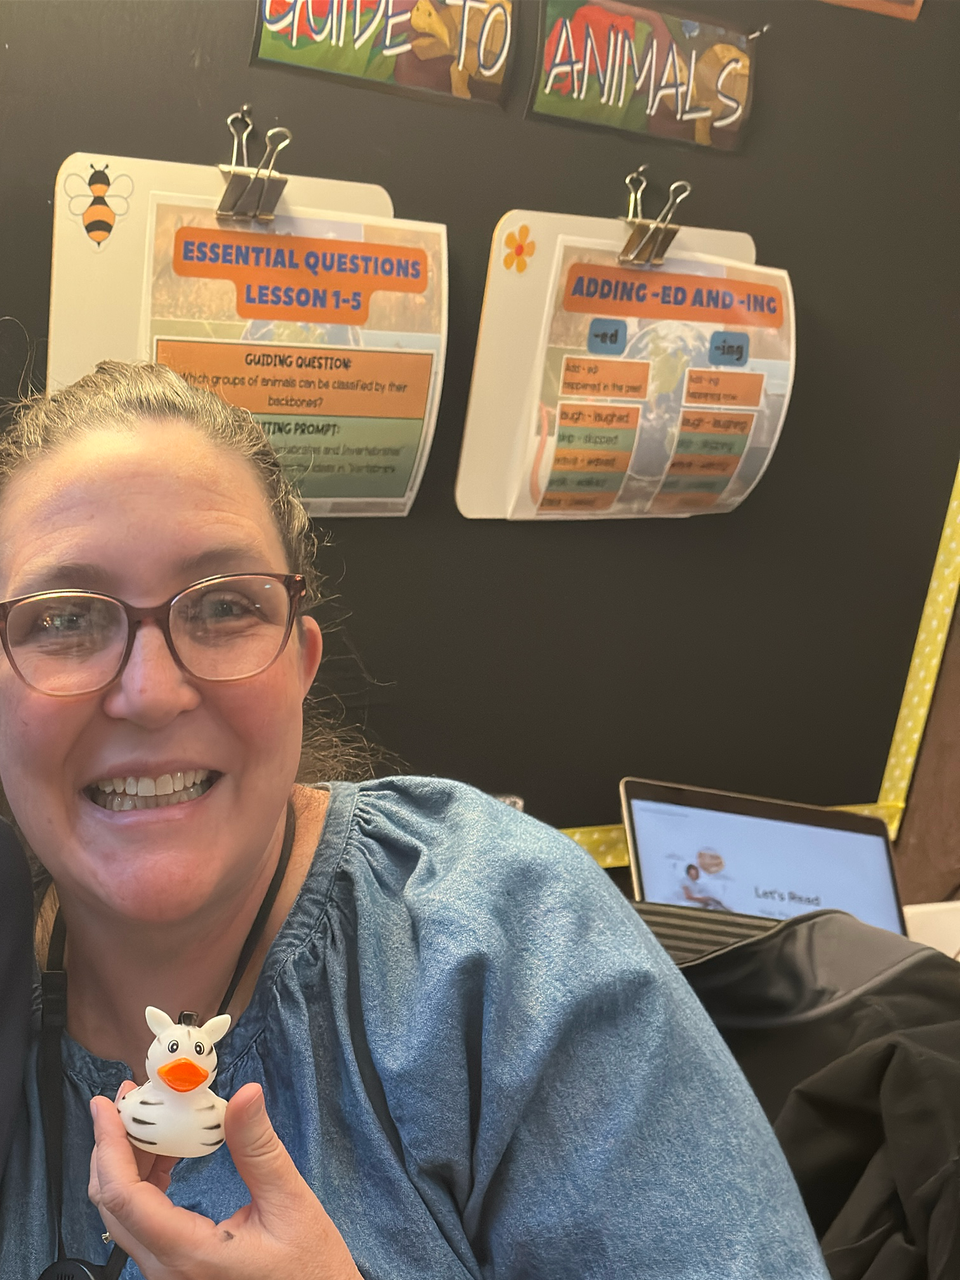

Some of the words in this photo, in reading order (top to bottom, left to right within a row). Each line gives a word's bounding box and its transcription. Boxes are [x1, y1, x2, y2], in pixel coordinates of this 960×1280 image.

[447, 0, 511, 76] TO
[543, 17, 743, 127] ANIMALS
[183, 240, 299, 269] ESSENTIAL
[304, 250, 421, 280] QUESTIONS
[245, 284, 328, 309] LESSON
[332, 290, 362, 311] 1-5
[571, 275, 647, 303] ADDING
[651, 286, 687, 306] -ED
[691, 287, 734, 310] AND
[737, 294, 778, 314] -ING
[593, 328, 619, 345] -ed
[245, 353, 293, 368] GUIDING
[715, 338, 744, 363] -ing
[211, 374, 246, 389] groups
[247, 374, 260, 386] of
[261, 375, 296, 389] animals
[298, 378, 316, 390] can
[317, 376, 330, 390] be
[374, 380, 386, 394] by
